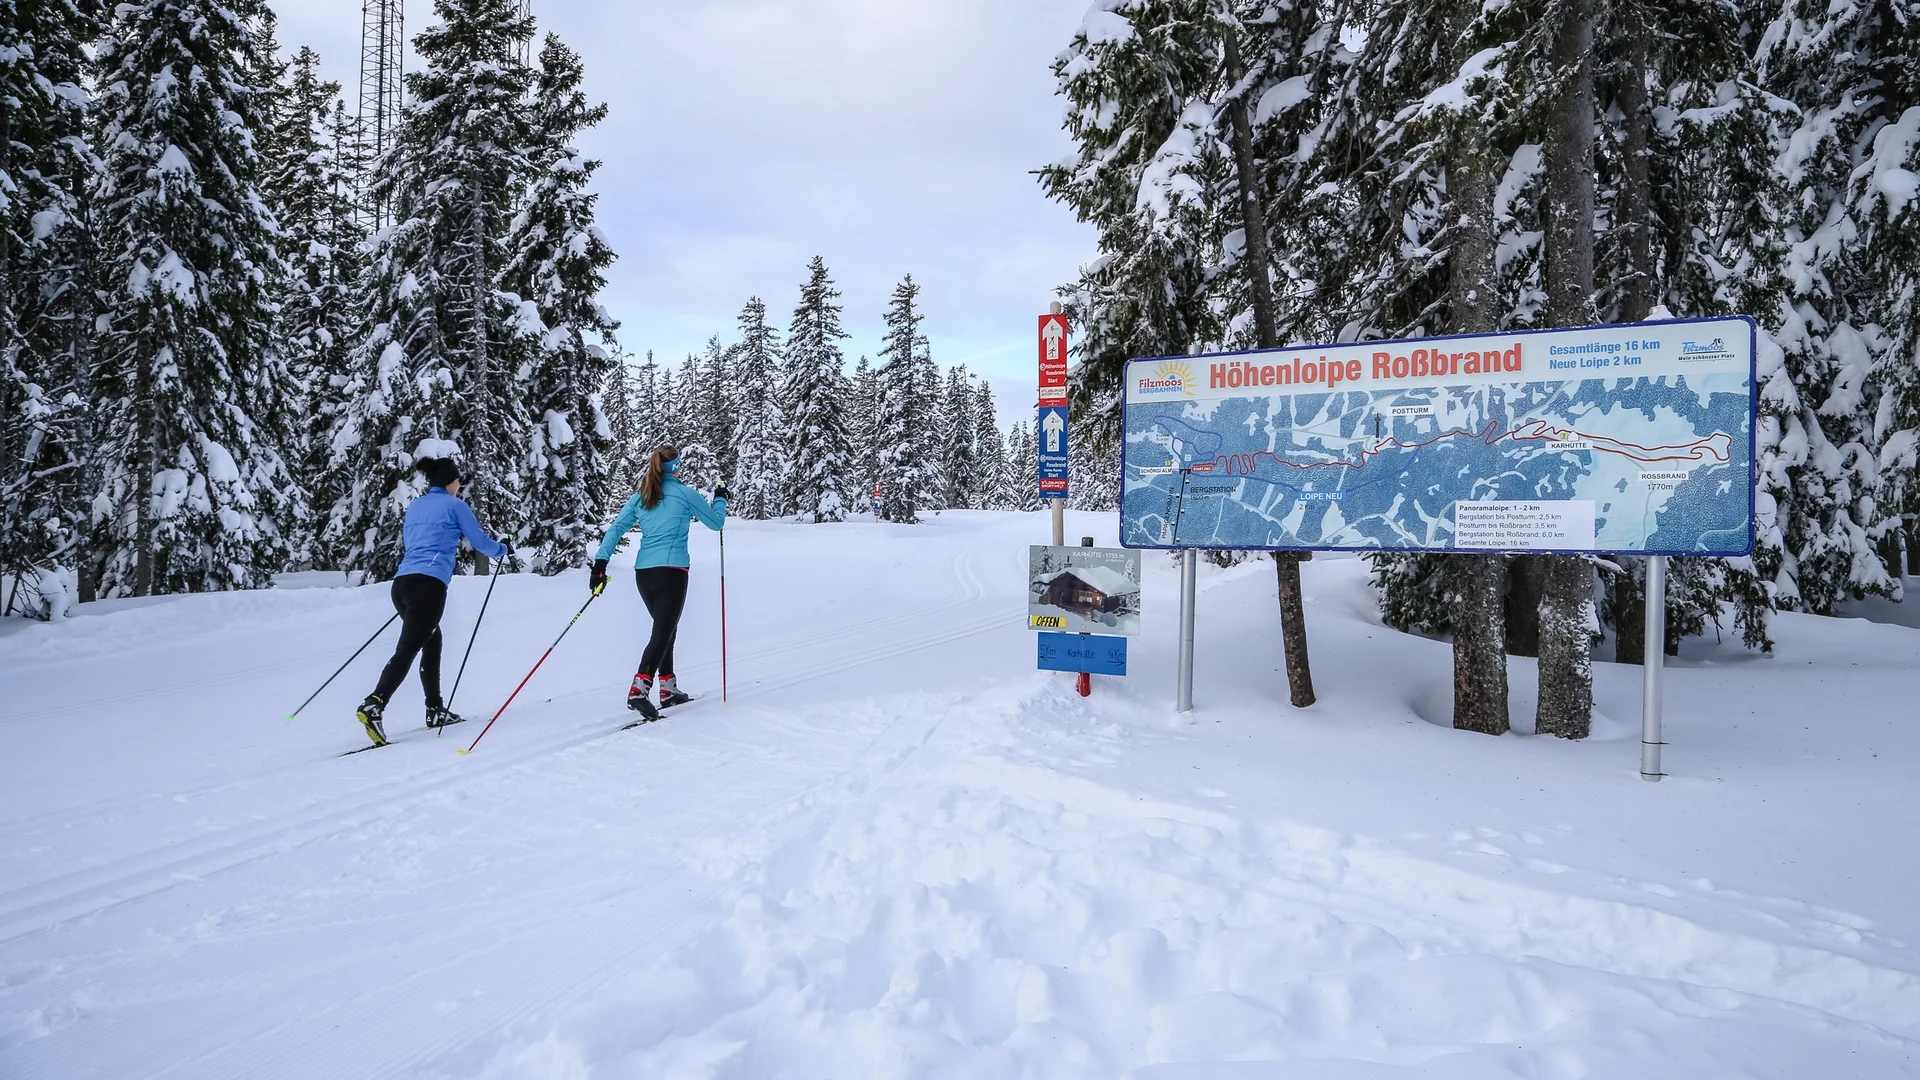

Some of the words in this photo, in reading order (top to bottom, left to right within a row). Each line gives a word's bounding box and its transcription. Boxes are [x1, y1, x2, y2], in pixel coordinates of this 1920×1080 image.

[1550, 342, 1621, 355] Gesamtlänge
[1625, 340, 1639, 351] 16
[1642, 339, 1660, 350] km
[1209, 356, 1361, 389] Höhenloipe
[1371, 343, 1522, 379] Roßbrand
[1550, 359, 1577, 370] Neue
[1580, 357, 1610, 369] Loipe
[1613, 356, 1621, 366] 2
[1623, 355, 1642, 366] km
[1139, 378, 1183, 389] Filzmoos
[1138, 386, 1183, 395] BERGBAHNEN
[1391, 406, 1429, 415] POSTTURM
[1190, 486, 1237, 494] BERGSTATION
[1647, 483, 1674, 491] 1770m
[1300, 492, 1324, 500] LOIPE
[1325, 492, 1343, 500] NEU
[1488, 539, 1508, 547] Loipe:
[1072, 550, 1102, 559] KARHÜTTE
[1036, 616, 1060, 627] OFFEN
